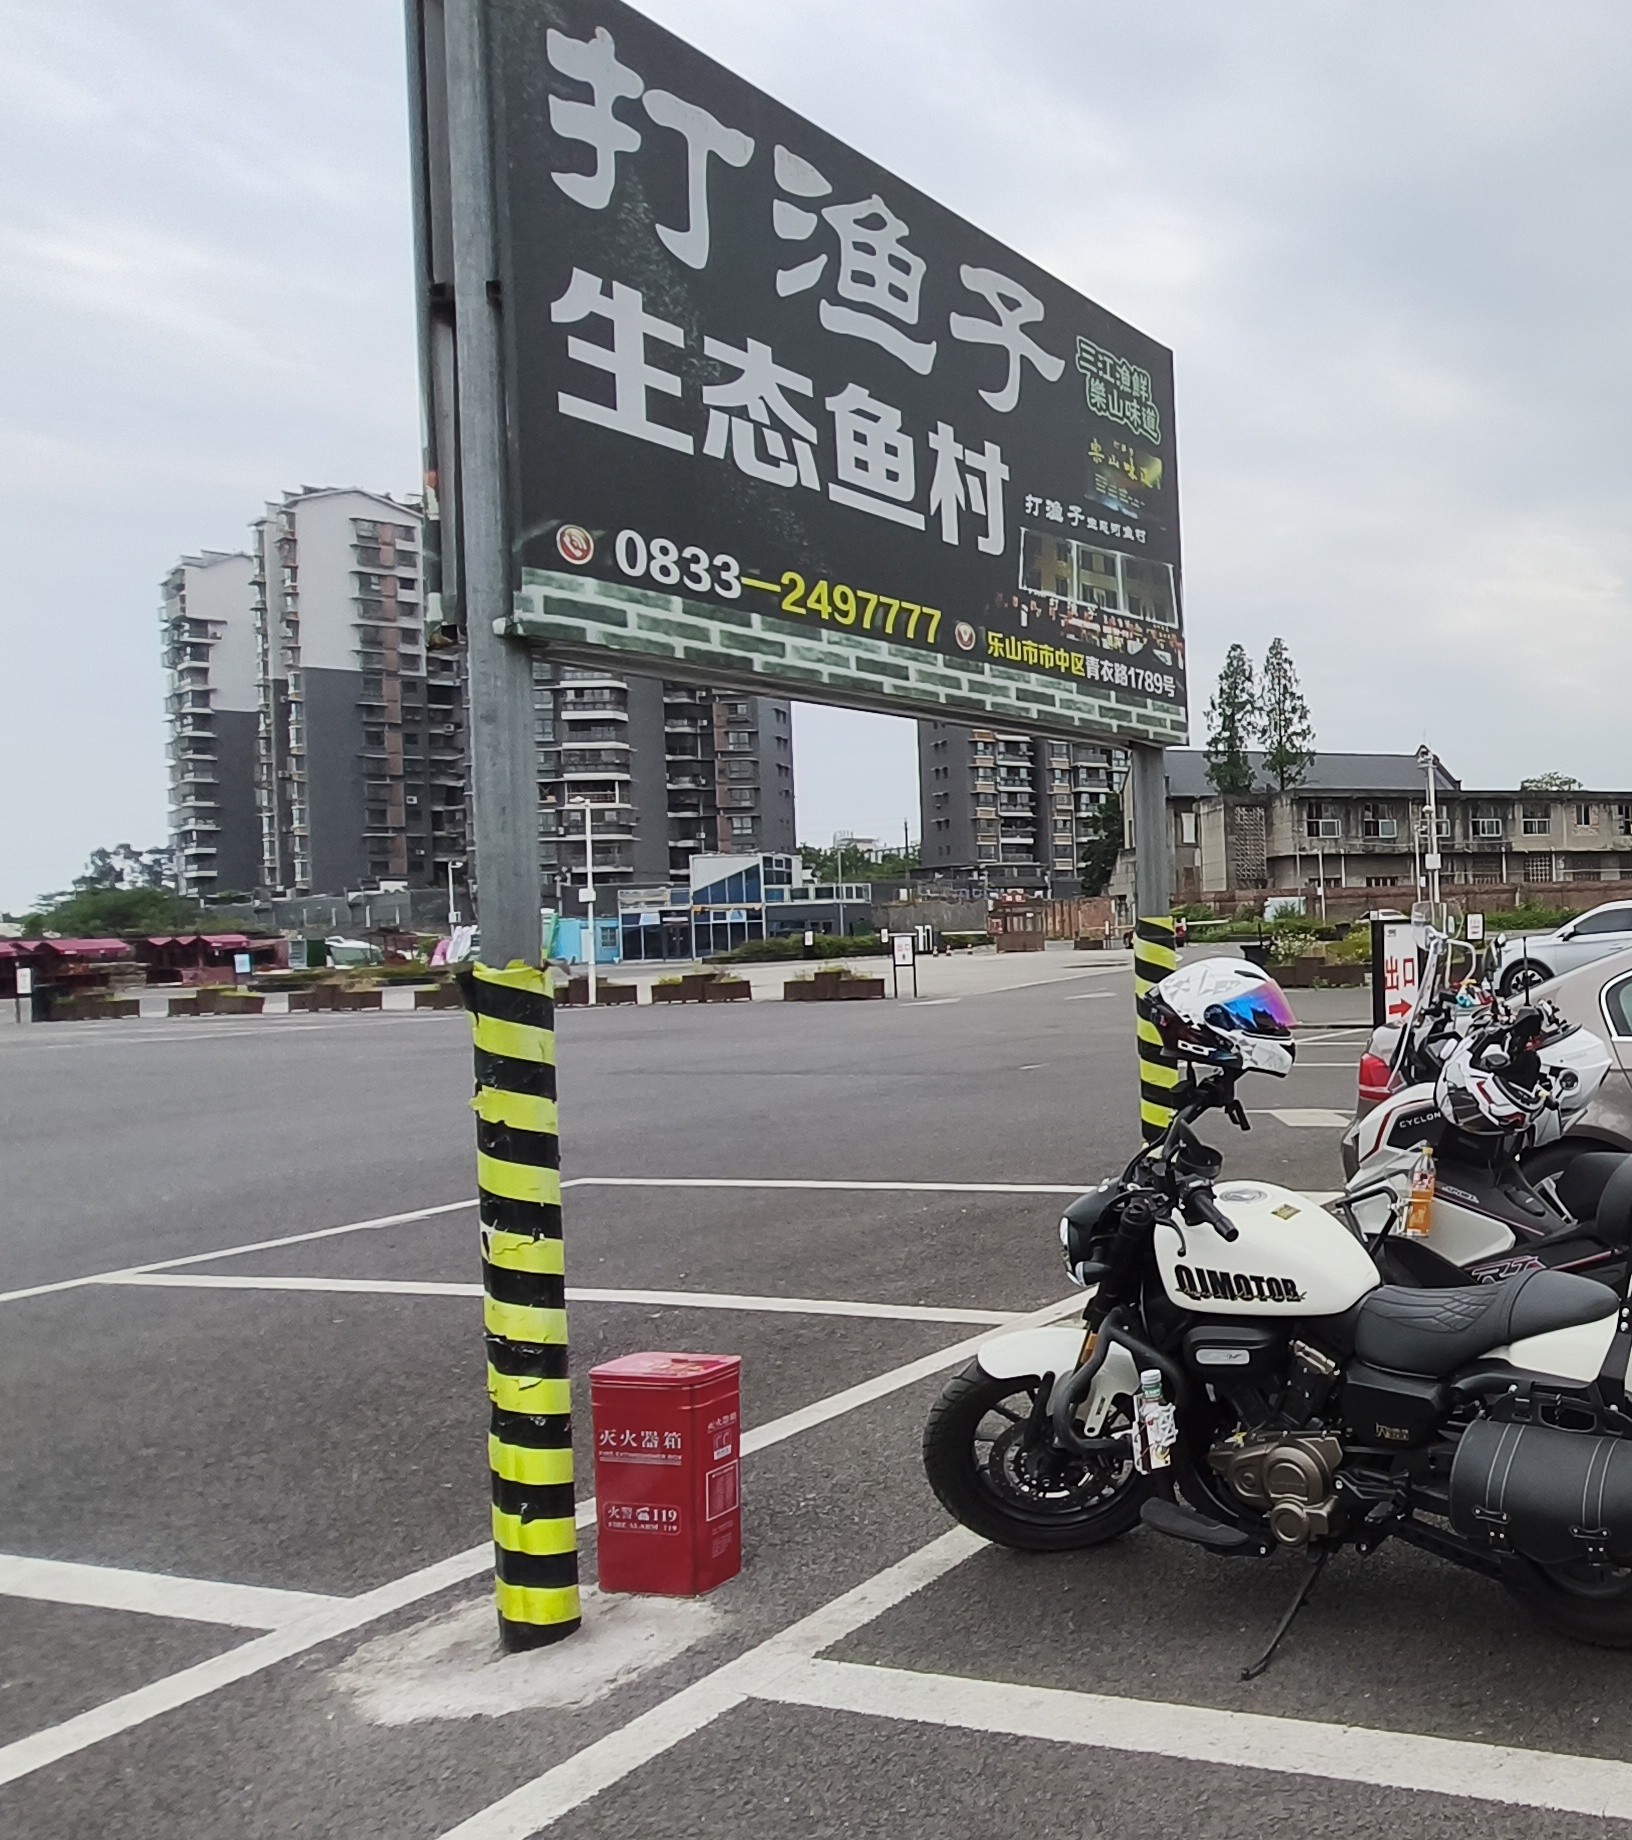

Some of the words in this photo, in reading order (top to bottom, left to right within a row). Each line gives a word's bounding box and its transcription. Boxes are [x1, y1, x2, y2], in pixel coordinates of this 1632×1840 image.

[546, 27, 1065, 412] 打渔子
[551, 267, 1010, 556] 生态鱼村
[1385, 956, 1415, 990] 出口
[598, 1428, 682, 1449] 灭火器箱
[653, 1509, 677, 1522] 119
